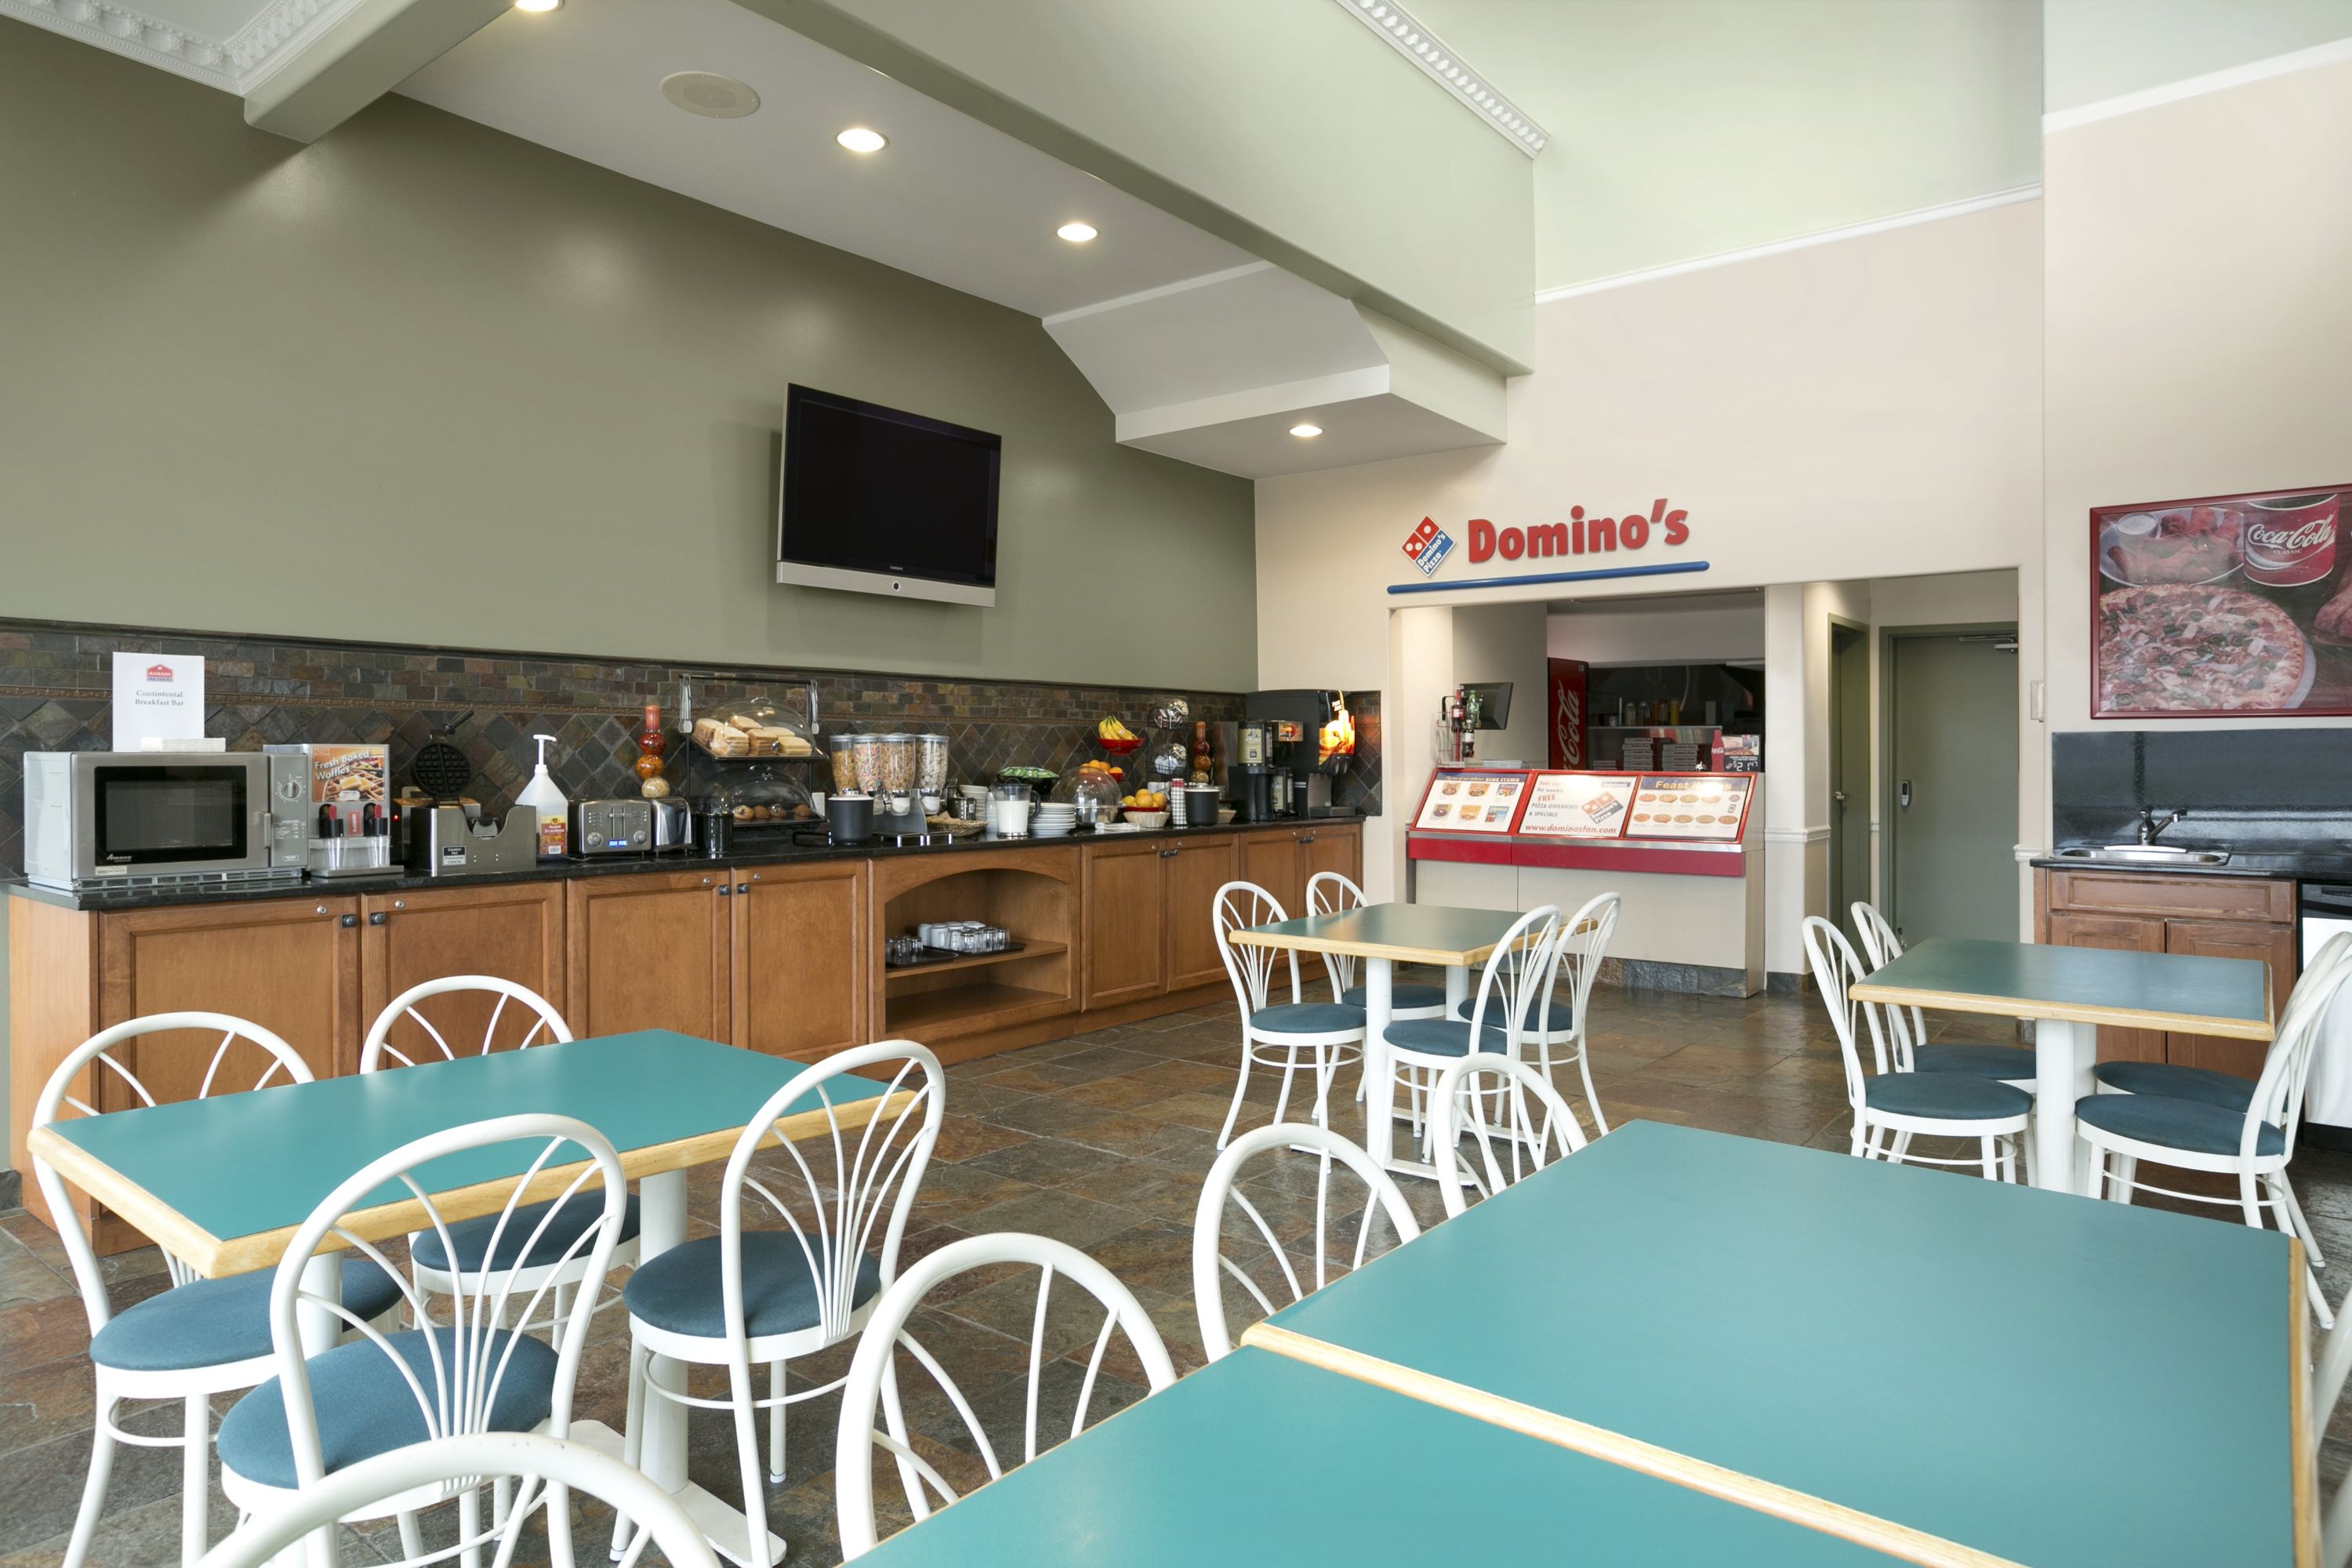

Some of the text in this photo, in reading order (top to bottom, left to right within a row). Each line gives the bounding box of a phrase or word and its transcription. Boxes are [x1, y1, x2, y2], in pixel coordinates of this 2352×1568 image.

[1468, 498, 1690, 563] Domino's
[2247, 514, 2335, 549] Coca-Cola
[1417, 533, 1446, 567] Domino's
[1422, 552, 1442, 572] Pizza
[314, 757, 339, 769] Fresh
[342, 746, 370, 763] Baked
[315, 765, 350, 780] Waffles
[1655, 781, 1689, 789] Feast
[1525, 824, 1617, 834] www.dominosfan.com
